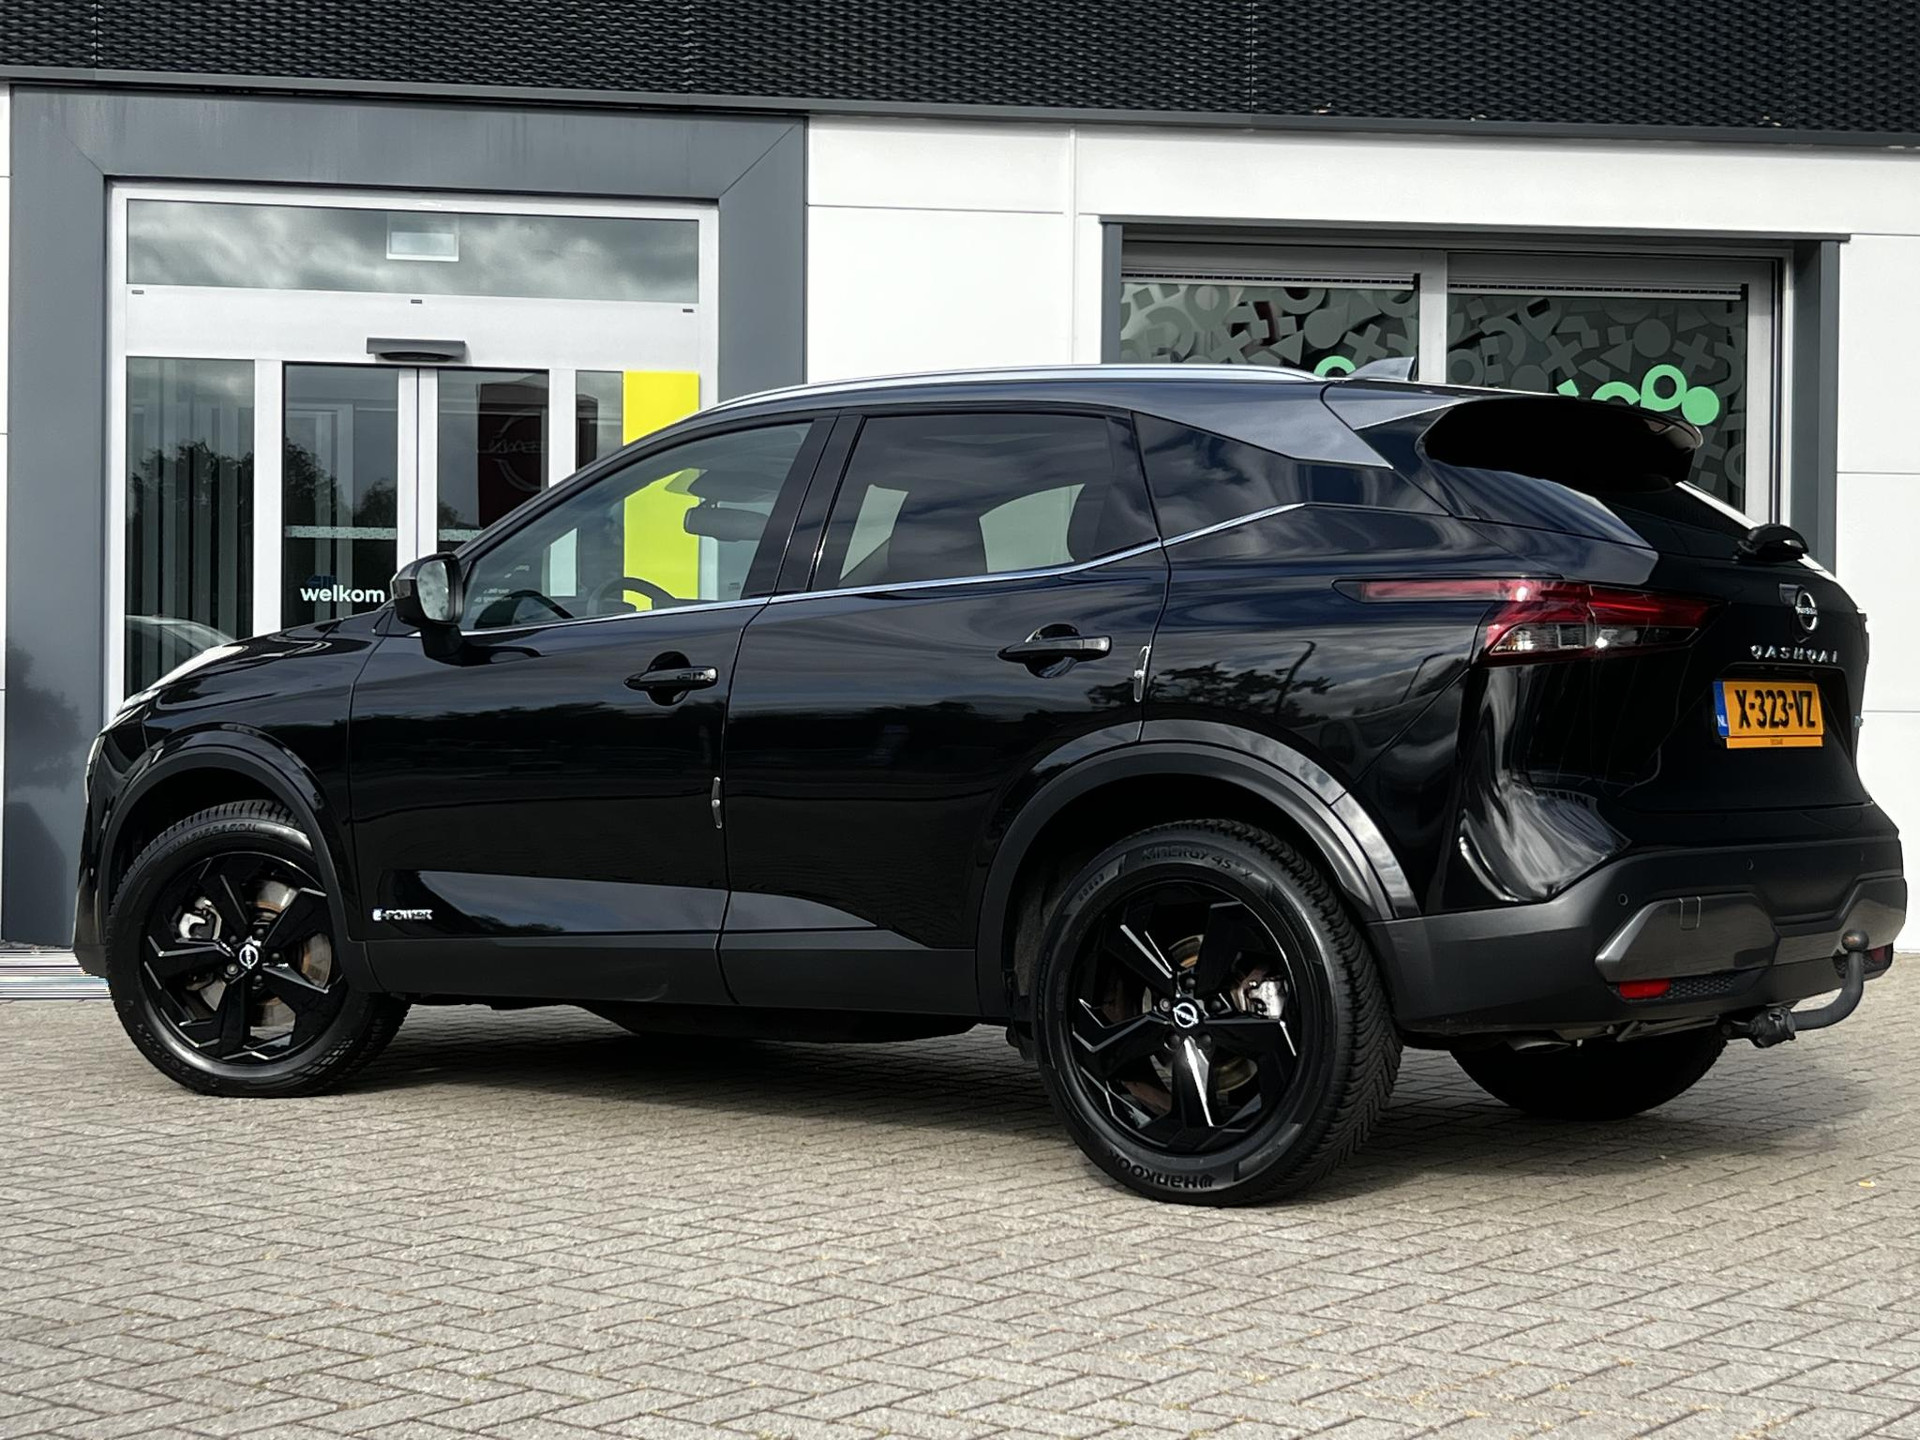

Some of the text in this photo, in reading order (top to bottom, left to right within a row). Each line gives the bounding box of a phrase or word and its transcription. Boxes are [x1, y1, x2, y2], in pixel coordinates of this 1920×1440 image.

[300, 584, 385, 603] welkom
[1750, 645, 1838, 663] QASHQAI
[1734, 690, 1816, 729] X-323-VZ
[1716, 714, 1728, 728] NL
